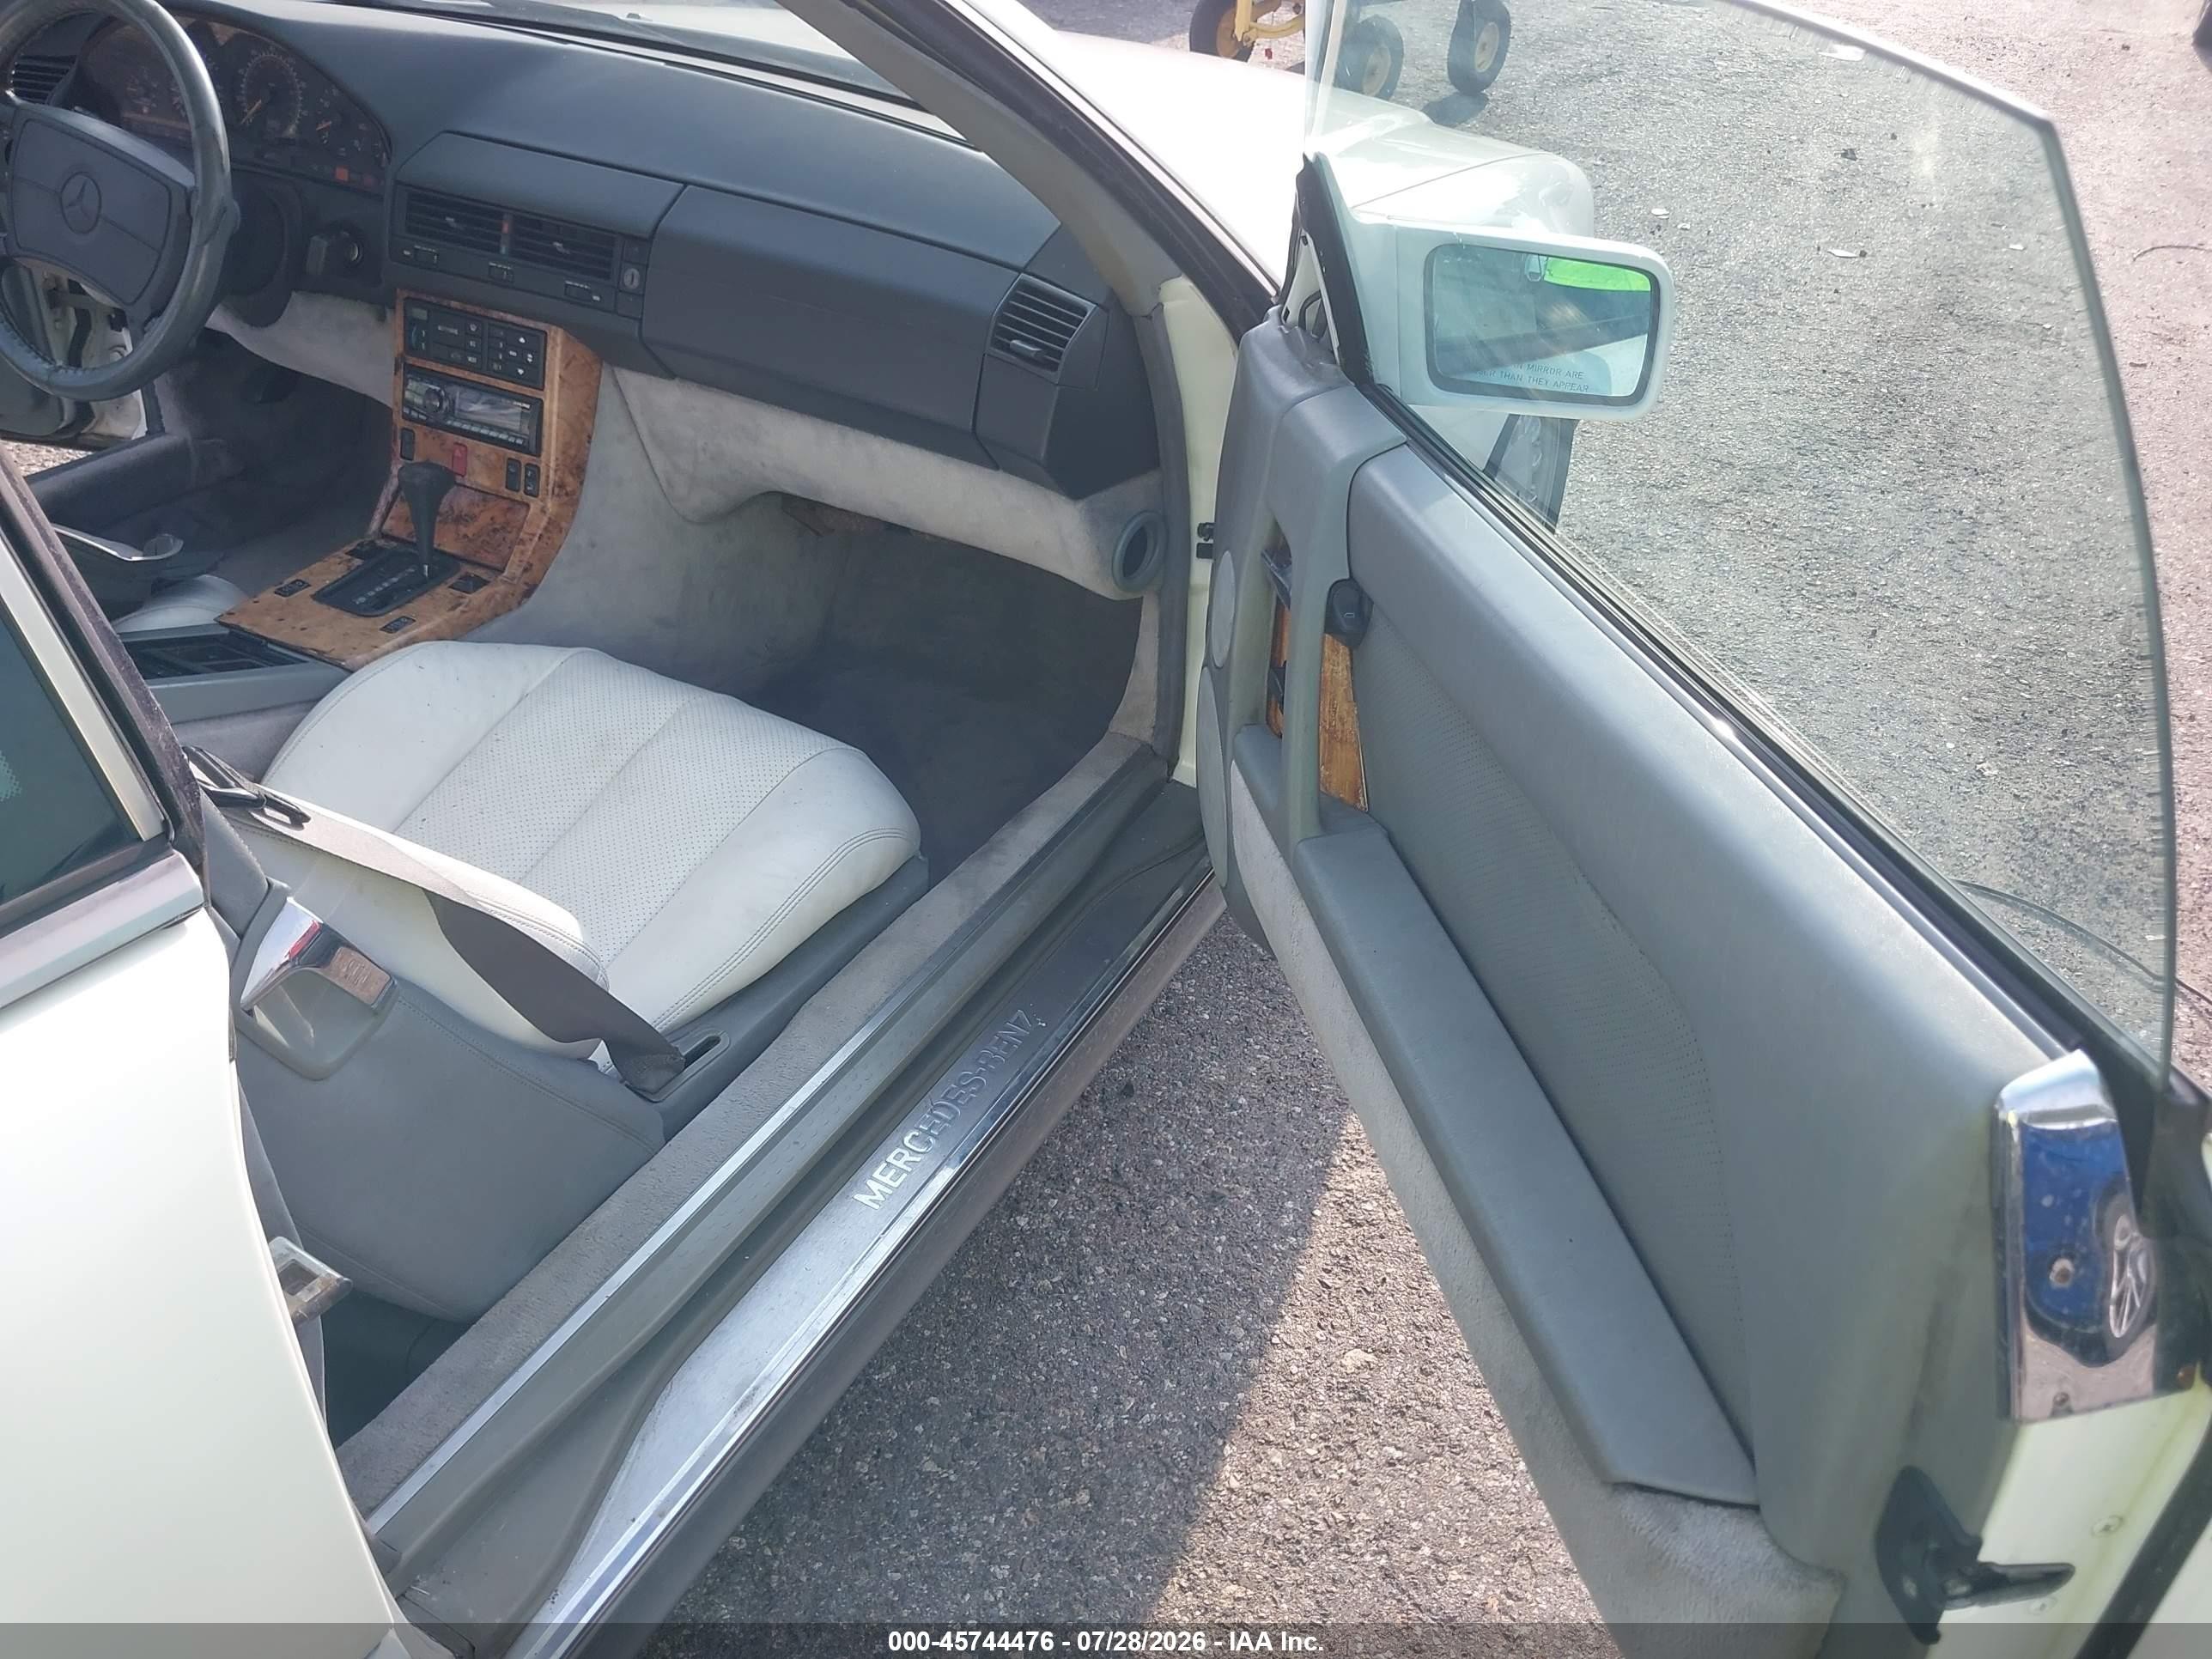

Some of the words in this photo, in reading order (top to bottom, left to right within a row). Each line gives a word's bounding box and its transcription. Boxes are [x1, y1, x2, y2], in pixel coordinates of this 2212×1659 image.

[1500, 370, 1522, 382] THAN
[1528, 375, 1548, 386] THEY
[1553, 380, 1589, 392] APPEAR
[1526, 363, 1562, 376] MIRROR
[1565, 370, 1585, 380] ARE
[852, 1008, 1032, 1211] MERCEDES-BENZ
